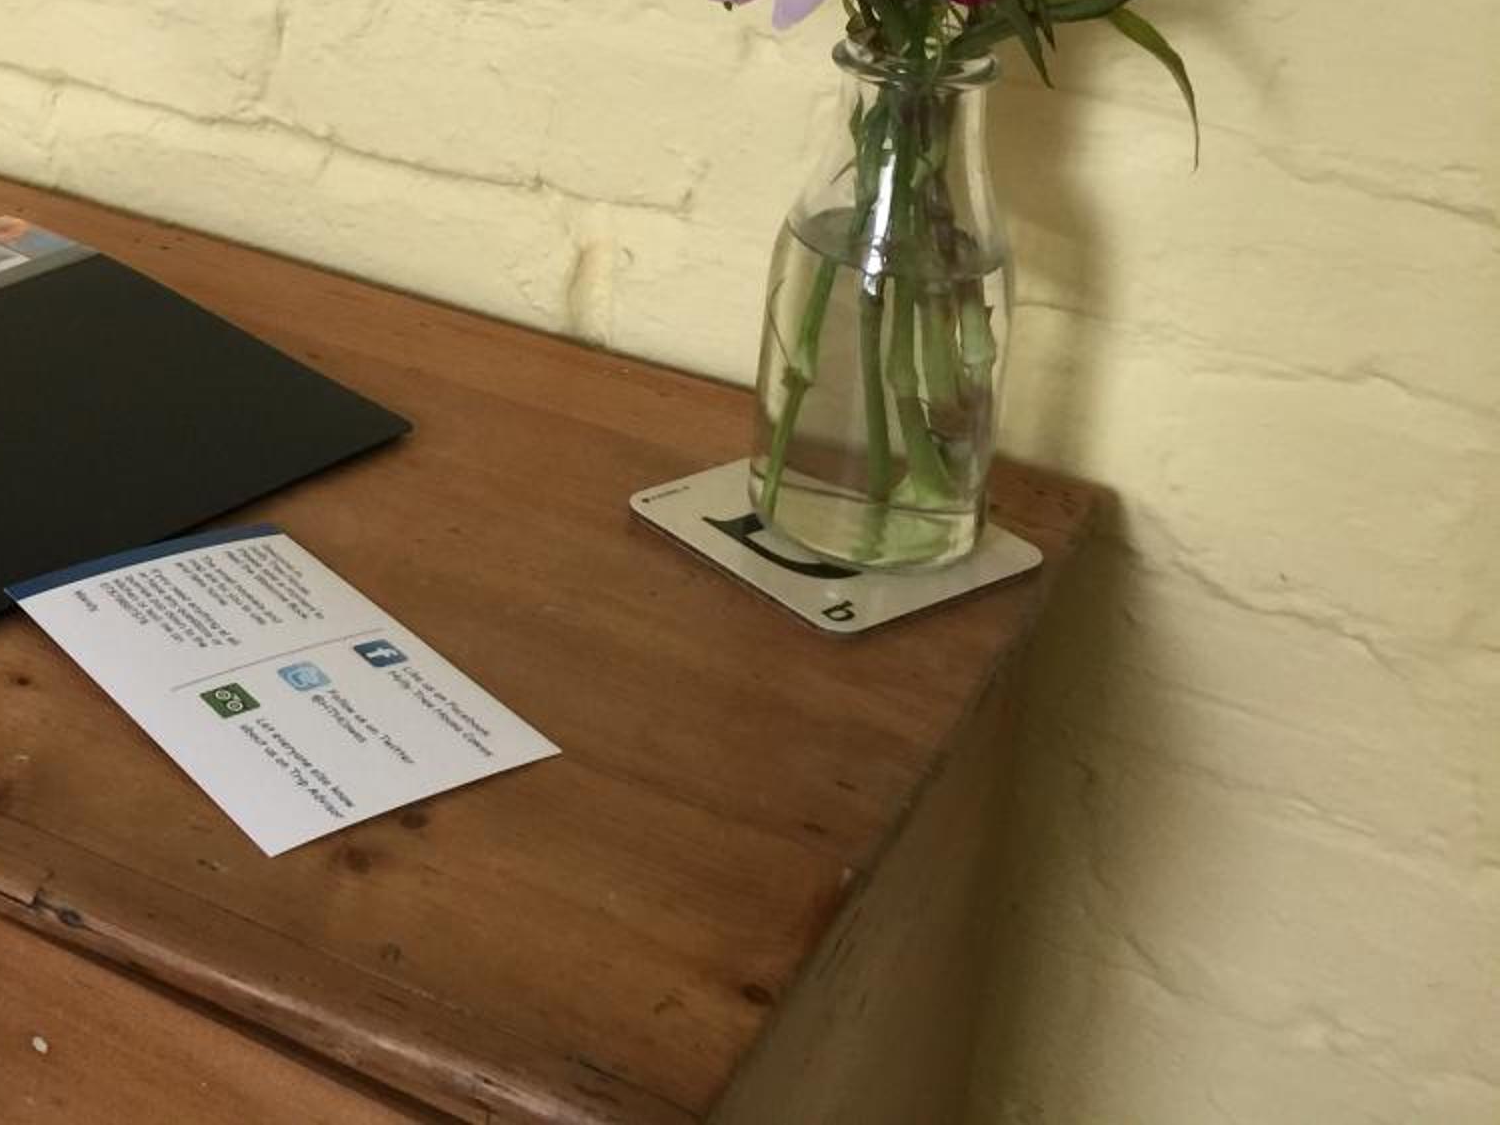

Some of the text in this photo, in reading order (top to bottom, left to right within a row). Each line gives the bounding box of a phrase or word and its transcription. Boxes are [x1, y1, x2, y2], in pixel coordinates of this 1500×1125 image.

[821, 600, 856, 623] b
[268, 732, 314, 768] everyone
[328, 785, 358, 807] know
[376, 734, 418, 765] Twitter
[263, 747, 278, 758] us
[274, 757, 291, 768] on
[284, 767, 312, 786] Trip
[306, 787, 346, 819] Advisor
